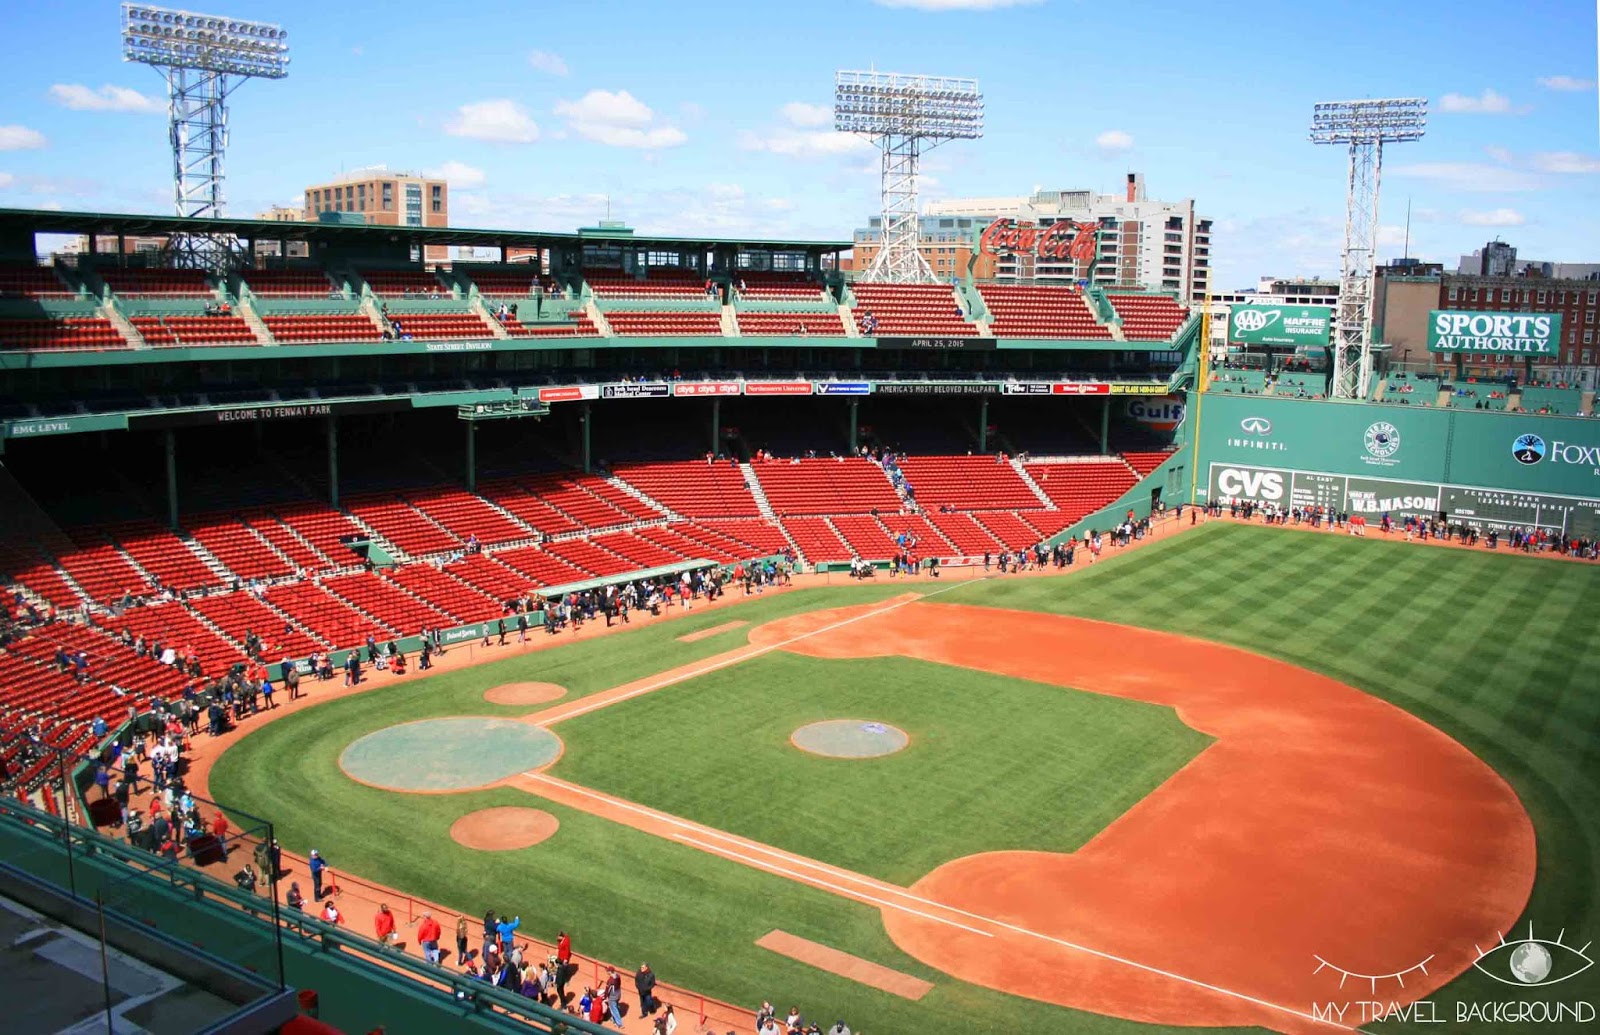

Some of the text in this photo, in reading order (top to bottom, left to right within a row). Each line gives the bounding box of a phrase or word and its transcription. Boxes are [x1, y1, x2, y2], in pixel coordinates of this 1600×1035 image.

[1238, 311, 1262, 331] AAA
[1283, 317, 1326, 327] MAPFRE
[1435, 313, 1550, 338] SPORTS
[1285, 327, 1323, 335] INSURANCE
[426, 343, 443, 351] STATE
[934, 340, 946, 348] 25,
[783, 384, 809, 392] University
[880, 385, 913, 393] AMERICA'S
[218, 405, 331, 421] WELCOME TO FENWAY PARK
[1129, 401, 1182, 420] Gulf
[13, 422, 70, 435] EMC LEVEL
[1218, 468, 1283, 500] CVS
[1464, 490, 1540, 503] FENWAY PARK
